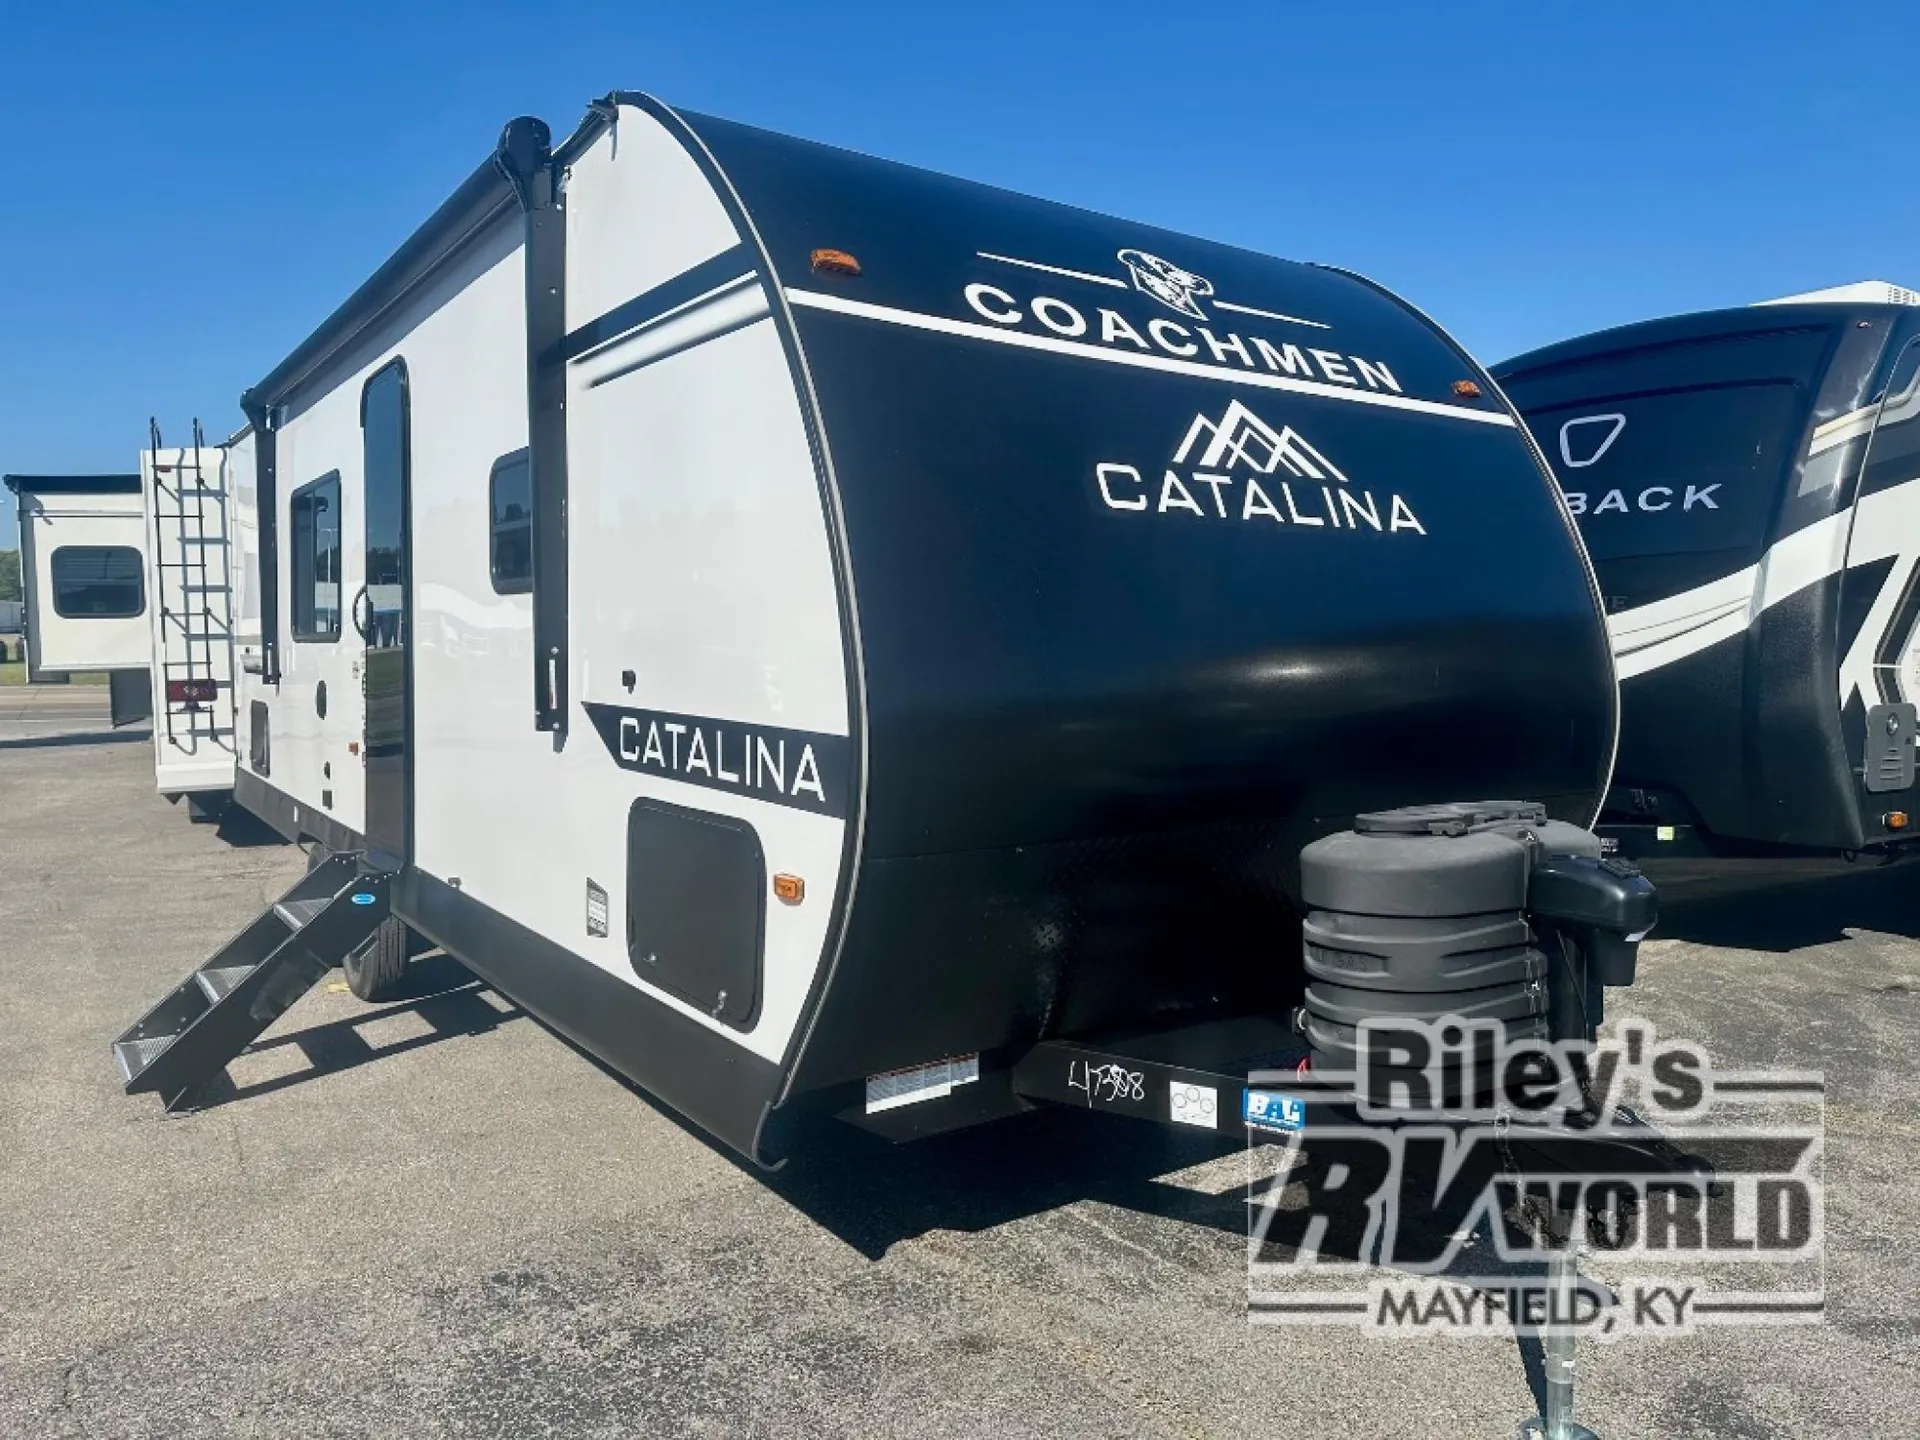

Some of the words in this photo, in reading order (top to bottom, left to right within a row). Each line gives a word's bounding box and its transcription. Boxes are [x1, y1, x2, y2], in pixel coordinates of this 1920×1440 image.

[963, 282, 1403, 393] COACHMEN
[1095, 462, 1428, 536] CATALINA
[619, 715, 826, 803] CATALINA
